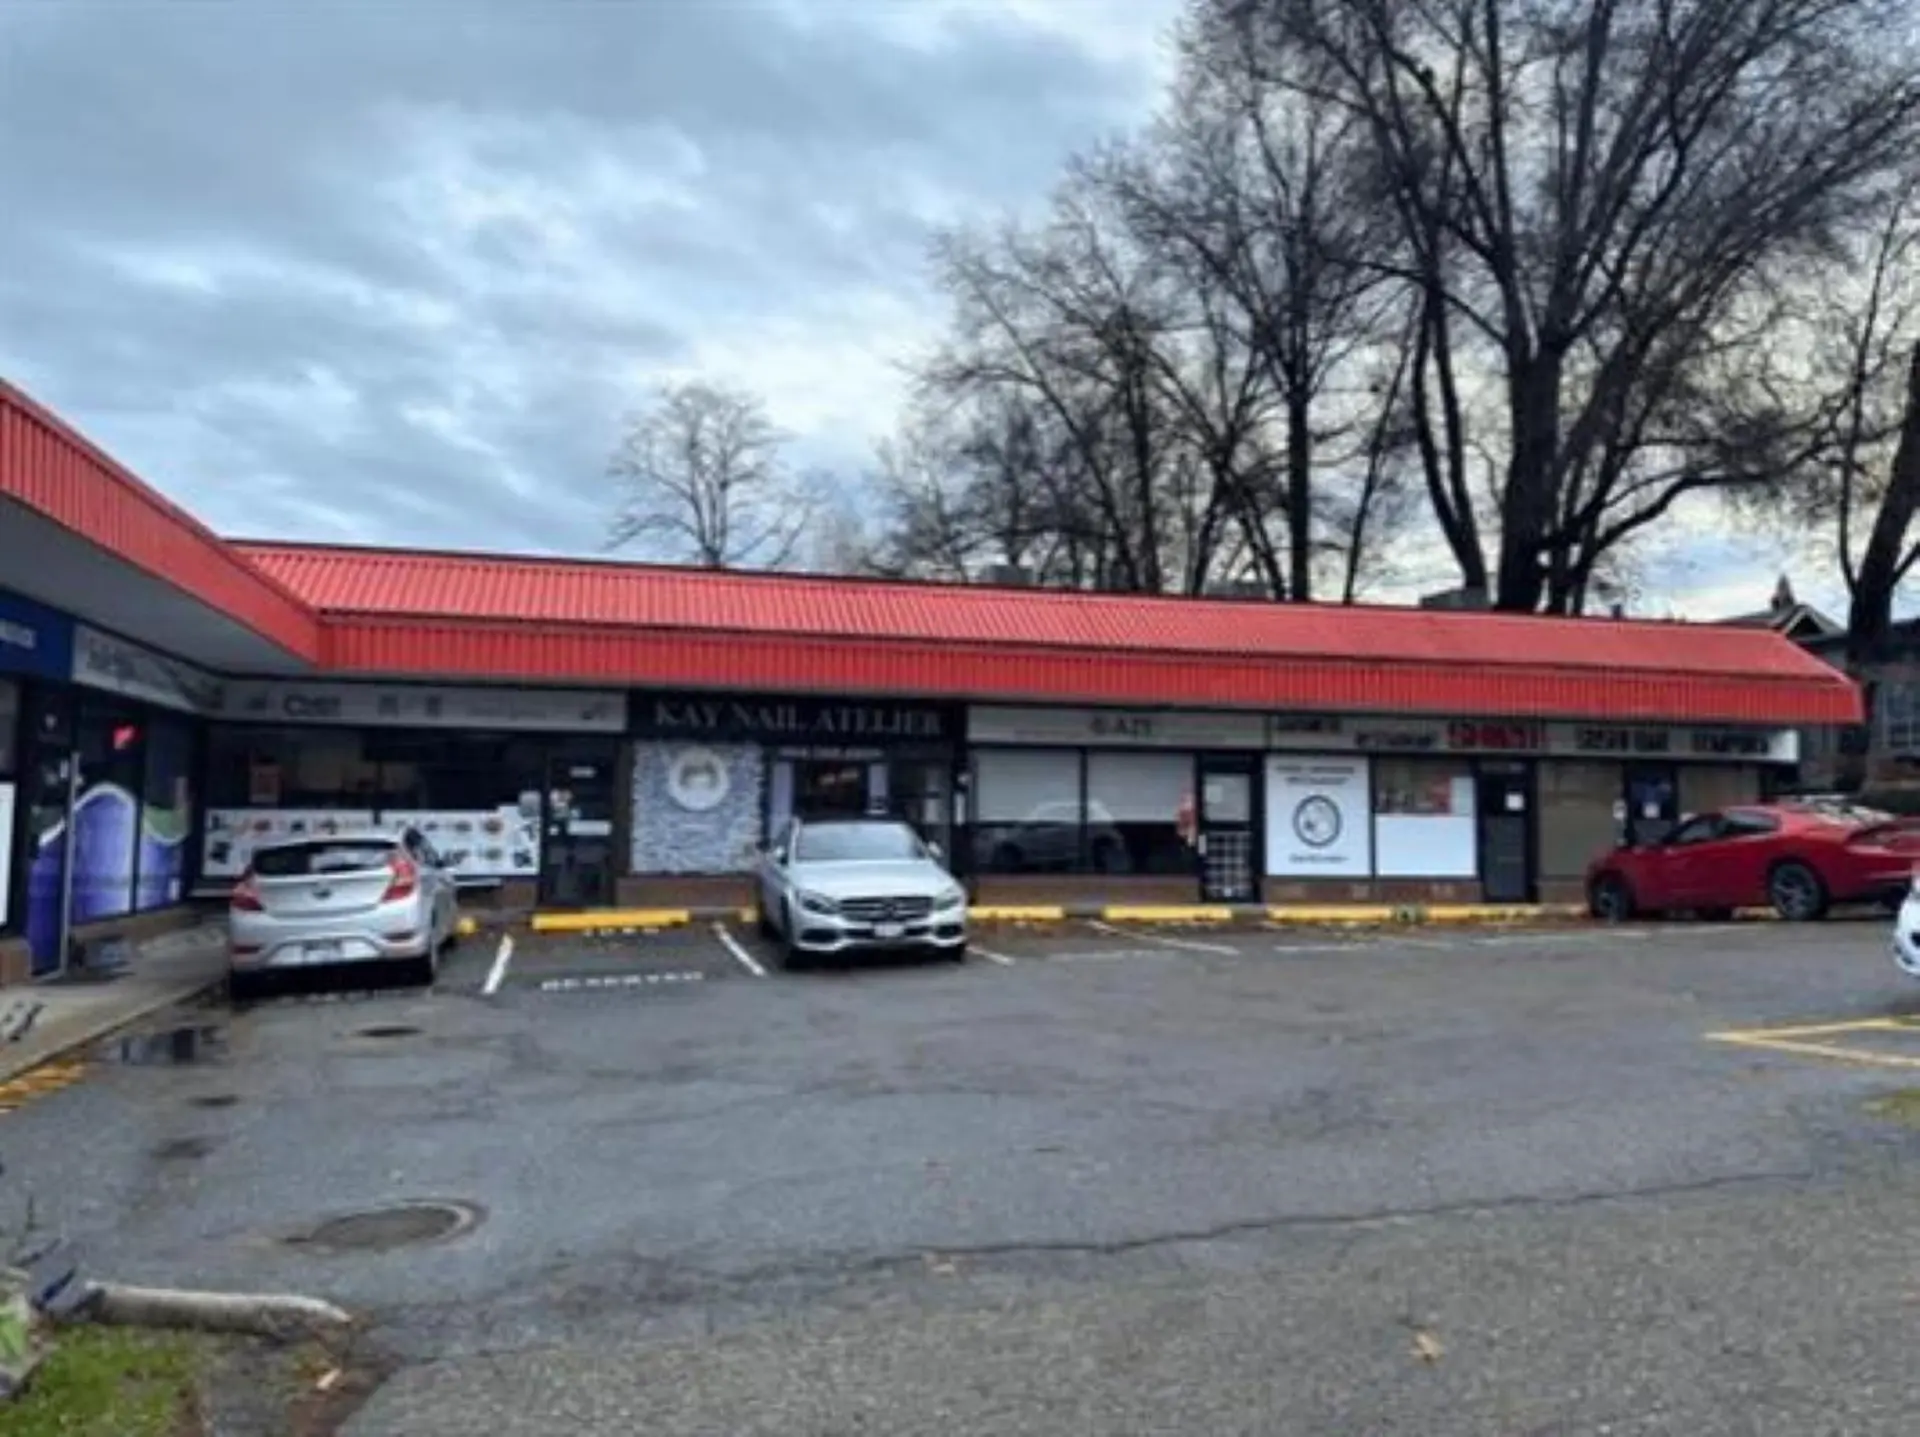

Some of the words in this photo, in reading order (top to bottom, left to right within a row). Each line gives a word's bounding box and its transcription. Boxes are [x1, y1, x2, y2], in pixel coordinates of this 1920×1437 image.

[655, 701, 723, 729] KAY
[730, 702, 806, 732] NAIL
[811, 706, 944, 736] ATELIER
